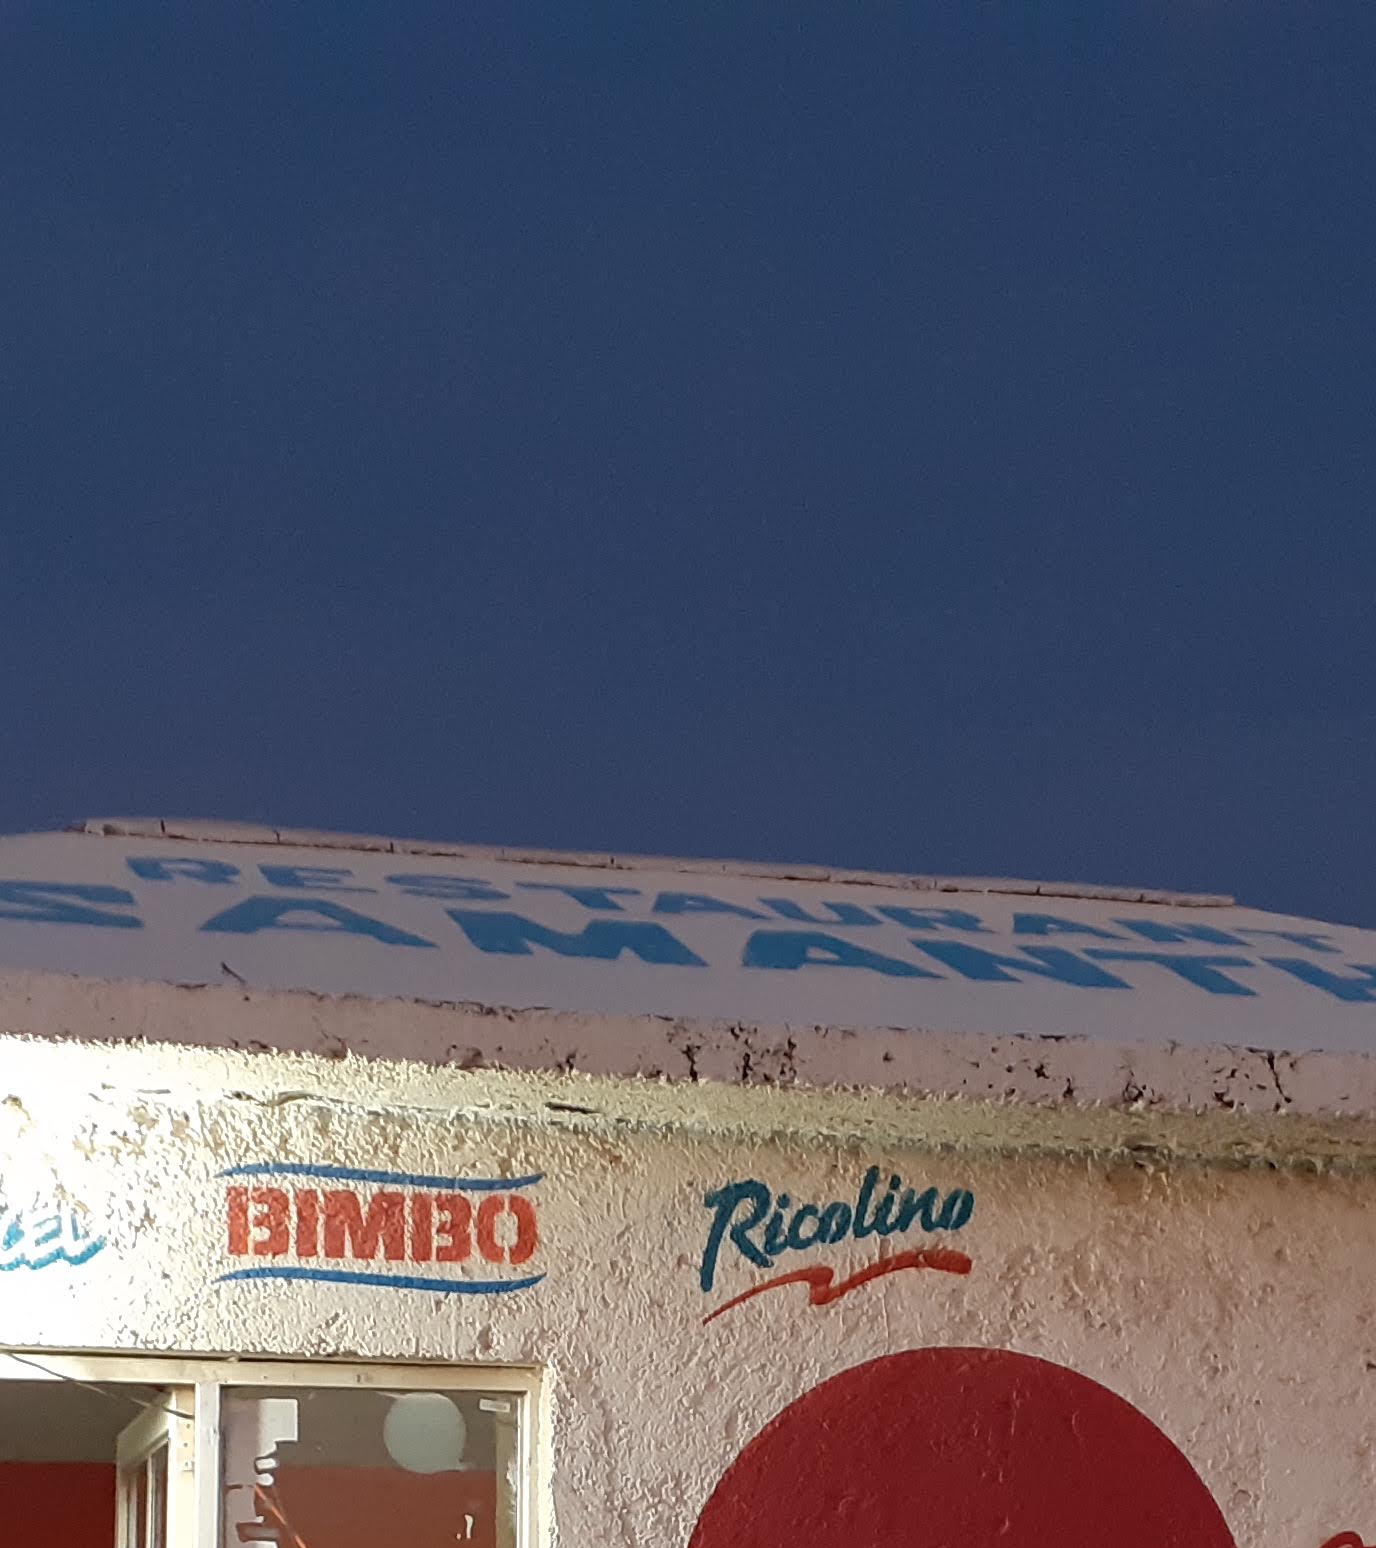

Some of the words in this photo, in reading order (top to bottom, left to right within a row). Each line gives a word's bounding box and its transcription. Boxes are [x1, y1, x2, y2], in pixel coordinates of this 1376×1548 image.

[126, 855, 1344, 953] RESTAURANT
[225, 1185, 539, 1265] BIMBO
[700, 1165, 974, 1292] Ricolino
